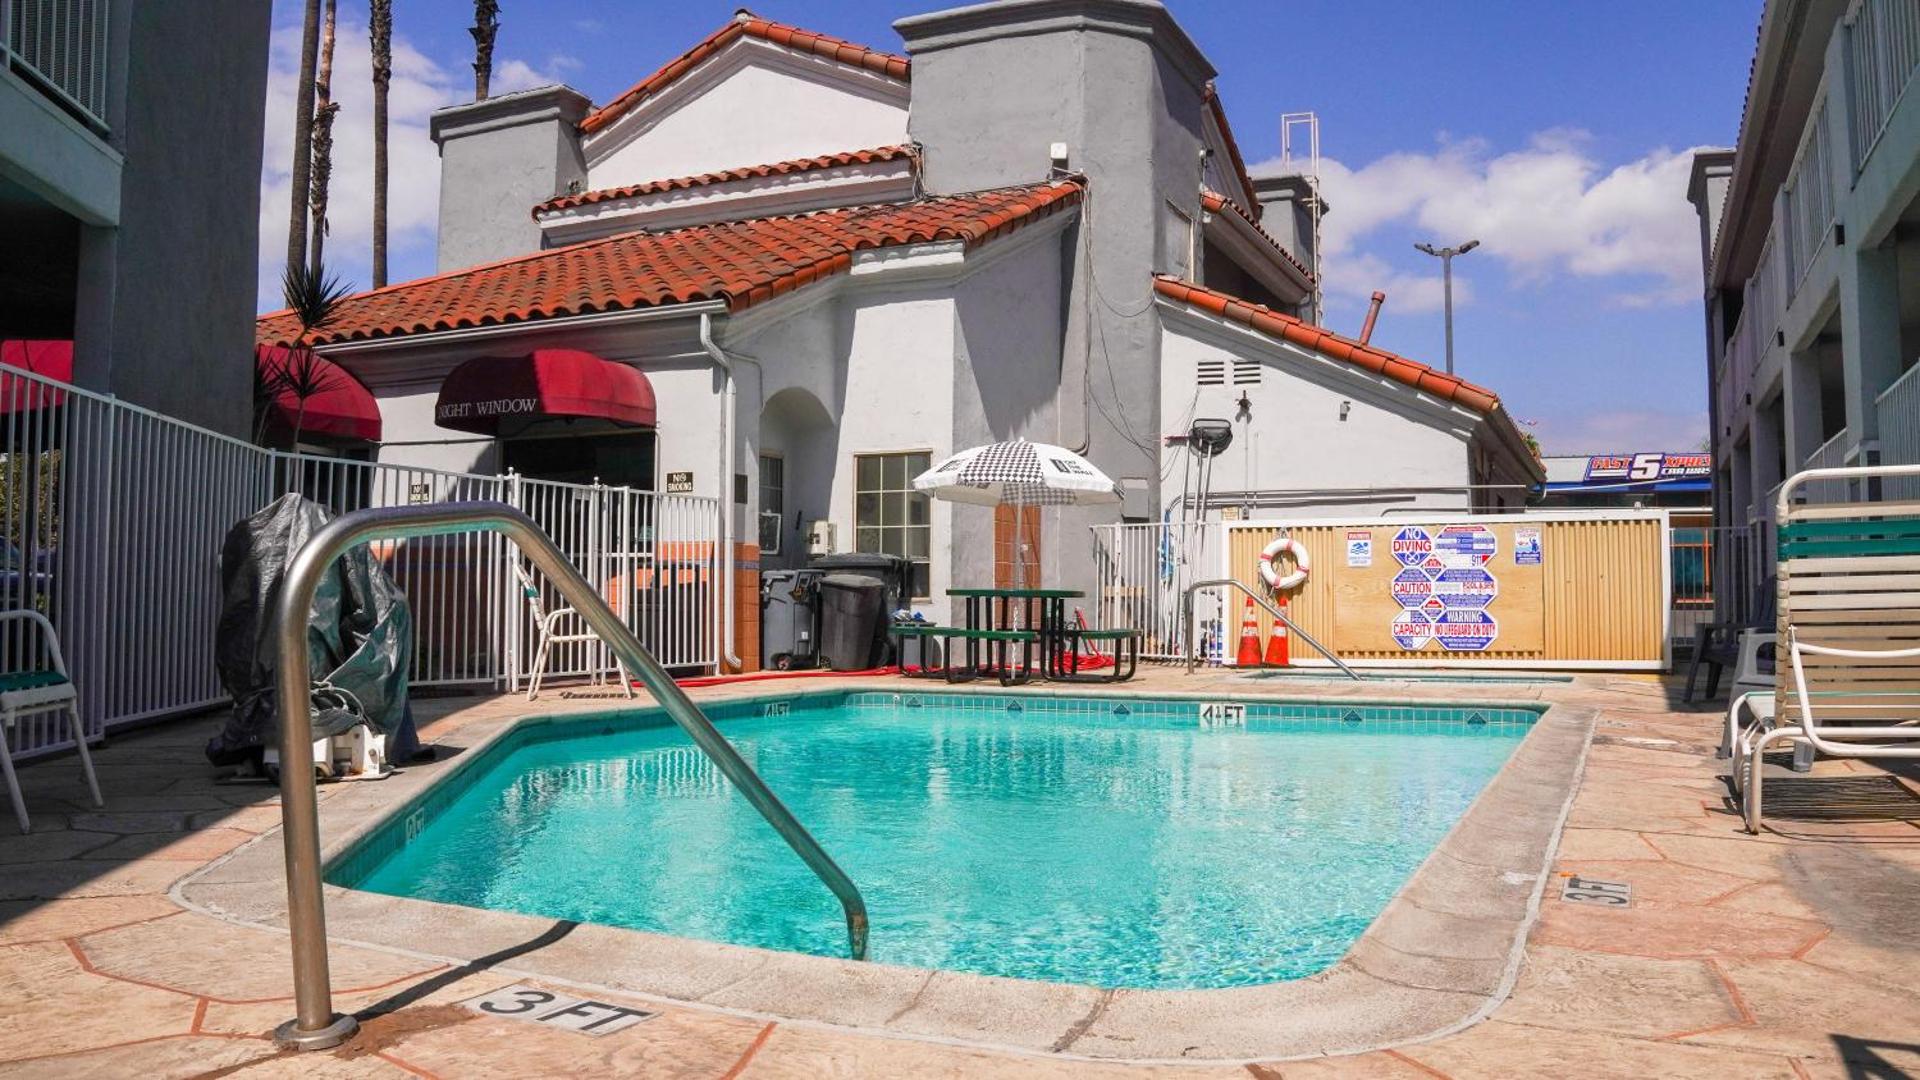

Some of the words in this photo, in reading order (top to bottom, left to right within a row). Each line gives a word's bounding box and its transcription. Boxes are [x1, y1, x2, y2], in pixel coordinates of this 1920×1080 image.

[439, 403, 472, 418] NIGHT
[477, 399, 537, 415] WINDOW
[1630, 454, 1663, 480] 5
[672, 473, 687, 483] NO
[1405, 527, 1421, 540] NO
[1393, 541, 1432, 552] DIVING
[1393, 583, 1432, 594] CAUTION
[1447, 610, 1483, 622] WARNING
[1393, 624, 1432, 636] CAPACITY
[1434, 624, 1442, 636] NO
[1444, 624, 1471, 636] LIFEGUARD
[1473, 624, 1481, 636] ON
[1482, 624, 1496, 636] DUTY
[479, 991, 555, 1014] 3
[535, 1001, 652, 1031] FT
